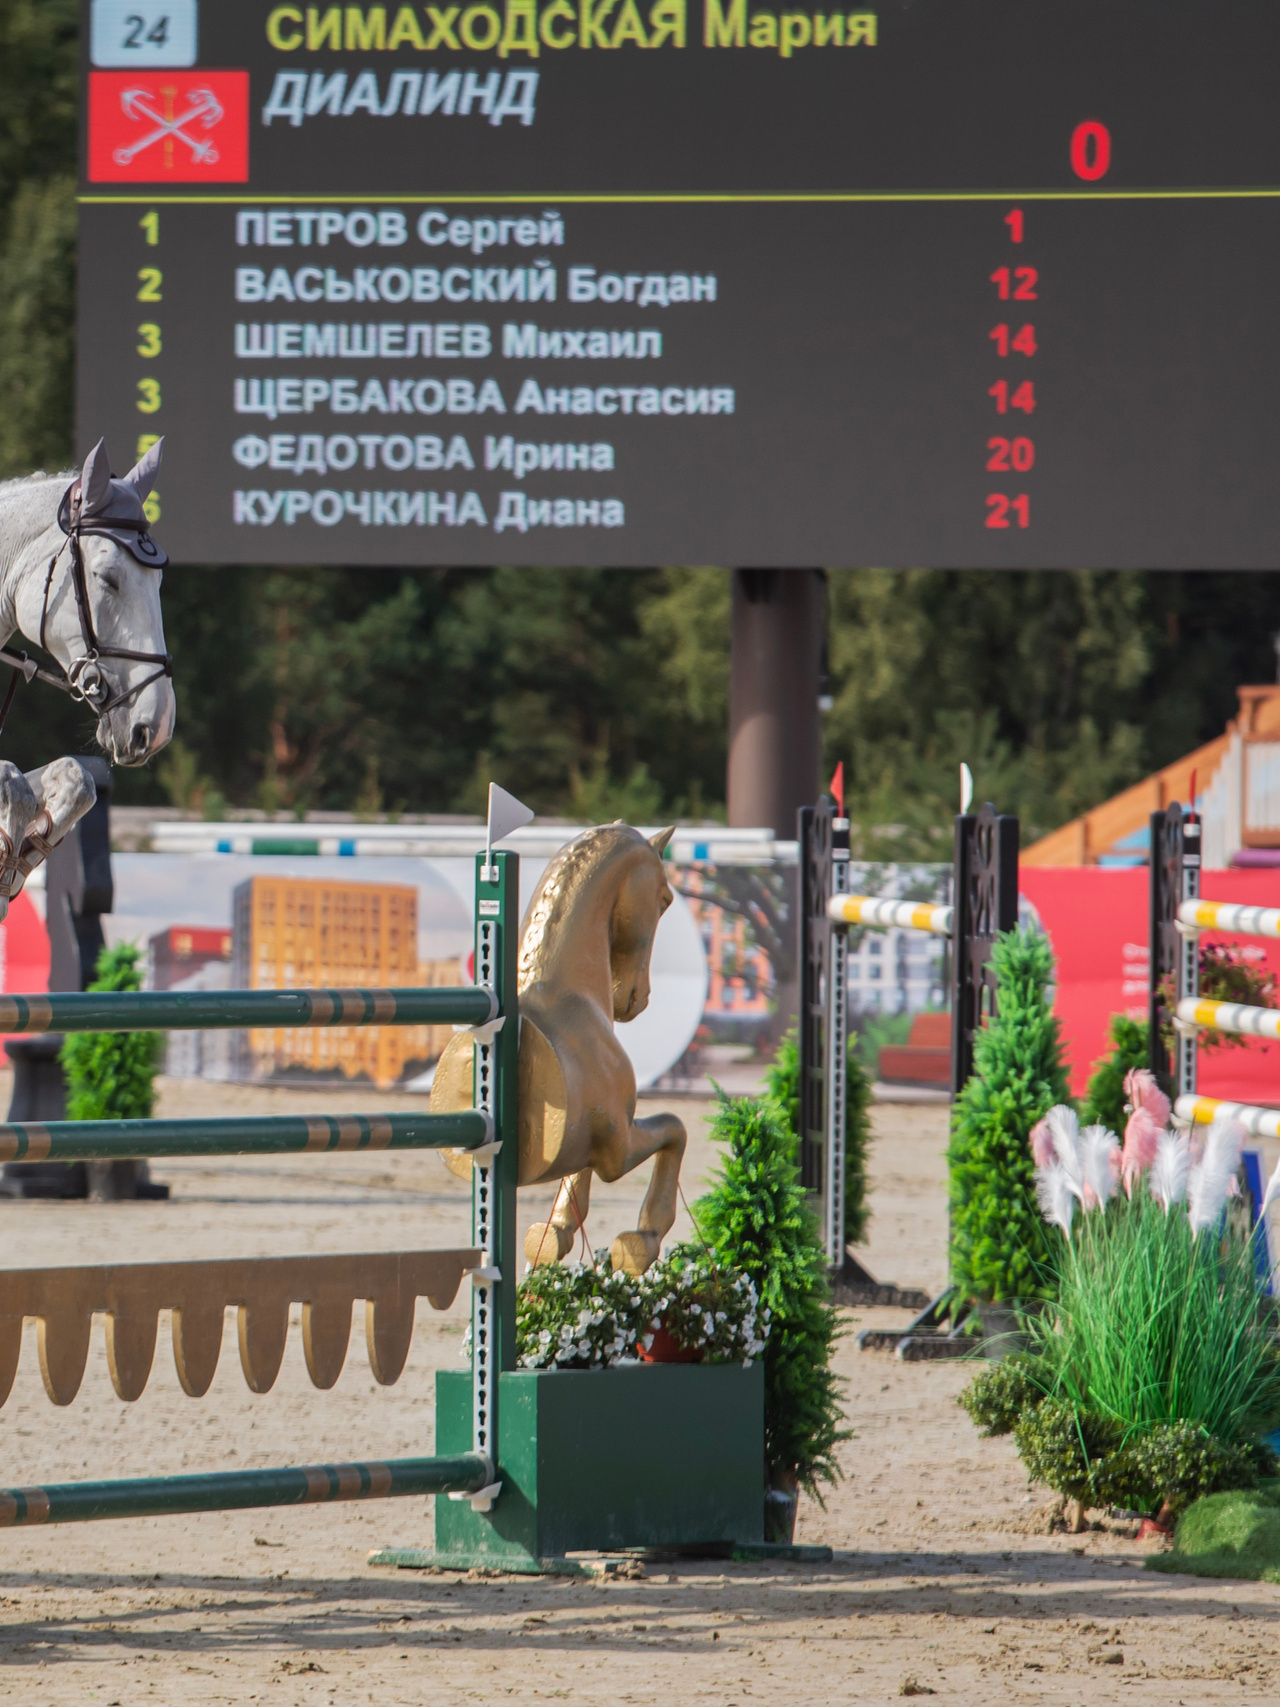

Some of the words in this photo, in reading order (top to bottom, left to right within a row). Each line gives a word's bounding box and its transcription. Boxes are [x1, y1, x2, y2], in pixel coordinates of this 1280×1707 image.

[122, 14, 172, 49] 24
[266, 0, 687, 59] СИМАХОДСКАЯ
[703, 0, 878, 58] Мария
[262, 69, 540, 127] ДИАЛИНД
[1070, 121, 1111, 181] 0
[139, 211, 159, 246] 1
[236, 210, 408, 247] ПЕТРОВ
[417, 210, 565, 255] Сергей
[1004, 209, 1024, 244] 1
[137, 267, 163, 302] 2
[235, 259, 557, 303] ВАСЬКОВСКИЙ
[567, 266, 717, 308] Богдан
[990, 266, 1038, 301] 12
[137, 323, 162, 358] 3
[234, 322, 492, 359] ШЕМШЕЛЕВ
[502, 323, 662, 359] Михаил
[989, 323, 1038, 357] 14
[137, 377, 162, 414] 3
[234, 377, 507, 421] ЩЕРБАКОВА
[514, 379, 735, 416] Анастасия
[988, 379, 1036, 414] 14
[232, 433, 475, 475] ФЕДОТОВА
[484, 435, 615, 480] Ирина
[986, 436, 1035, 472] 20
[233, 489, 488, 527] КУРОЧКИНА
[493, 491, 625, 533] Диана
[985, 493, 1030, 529] 21
